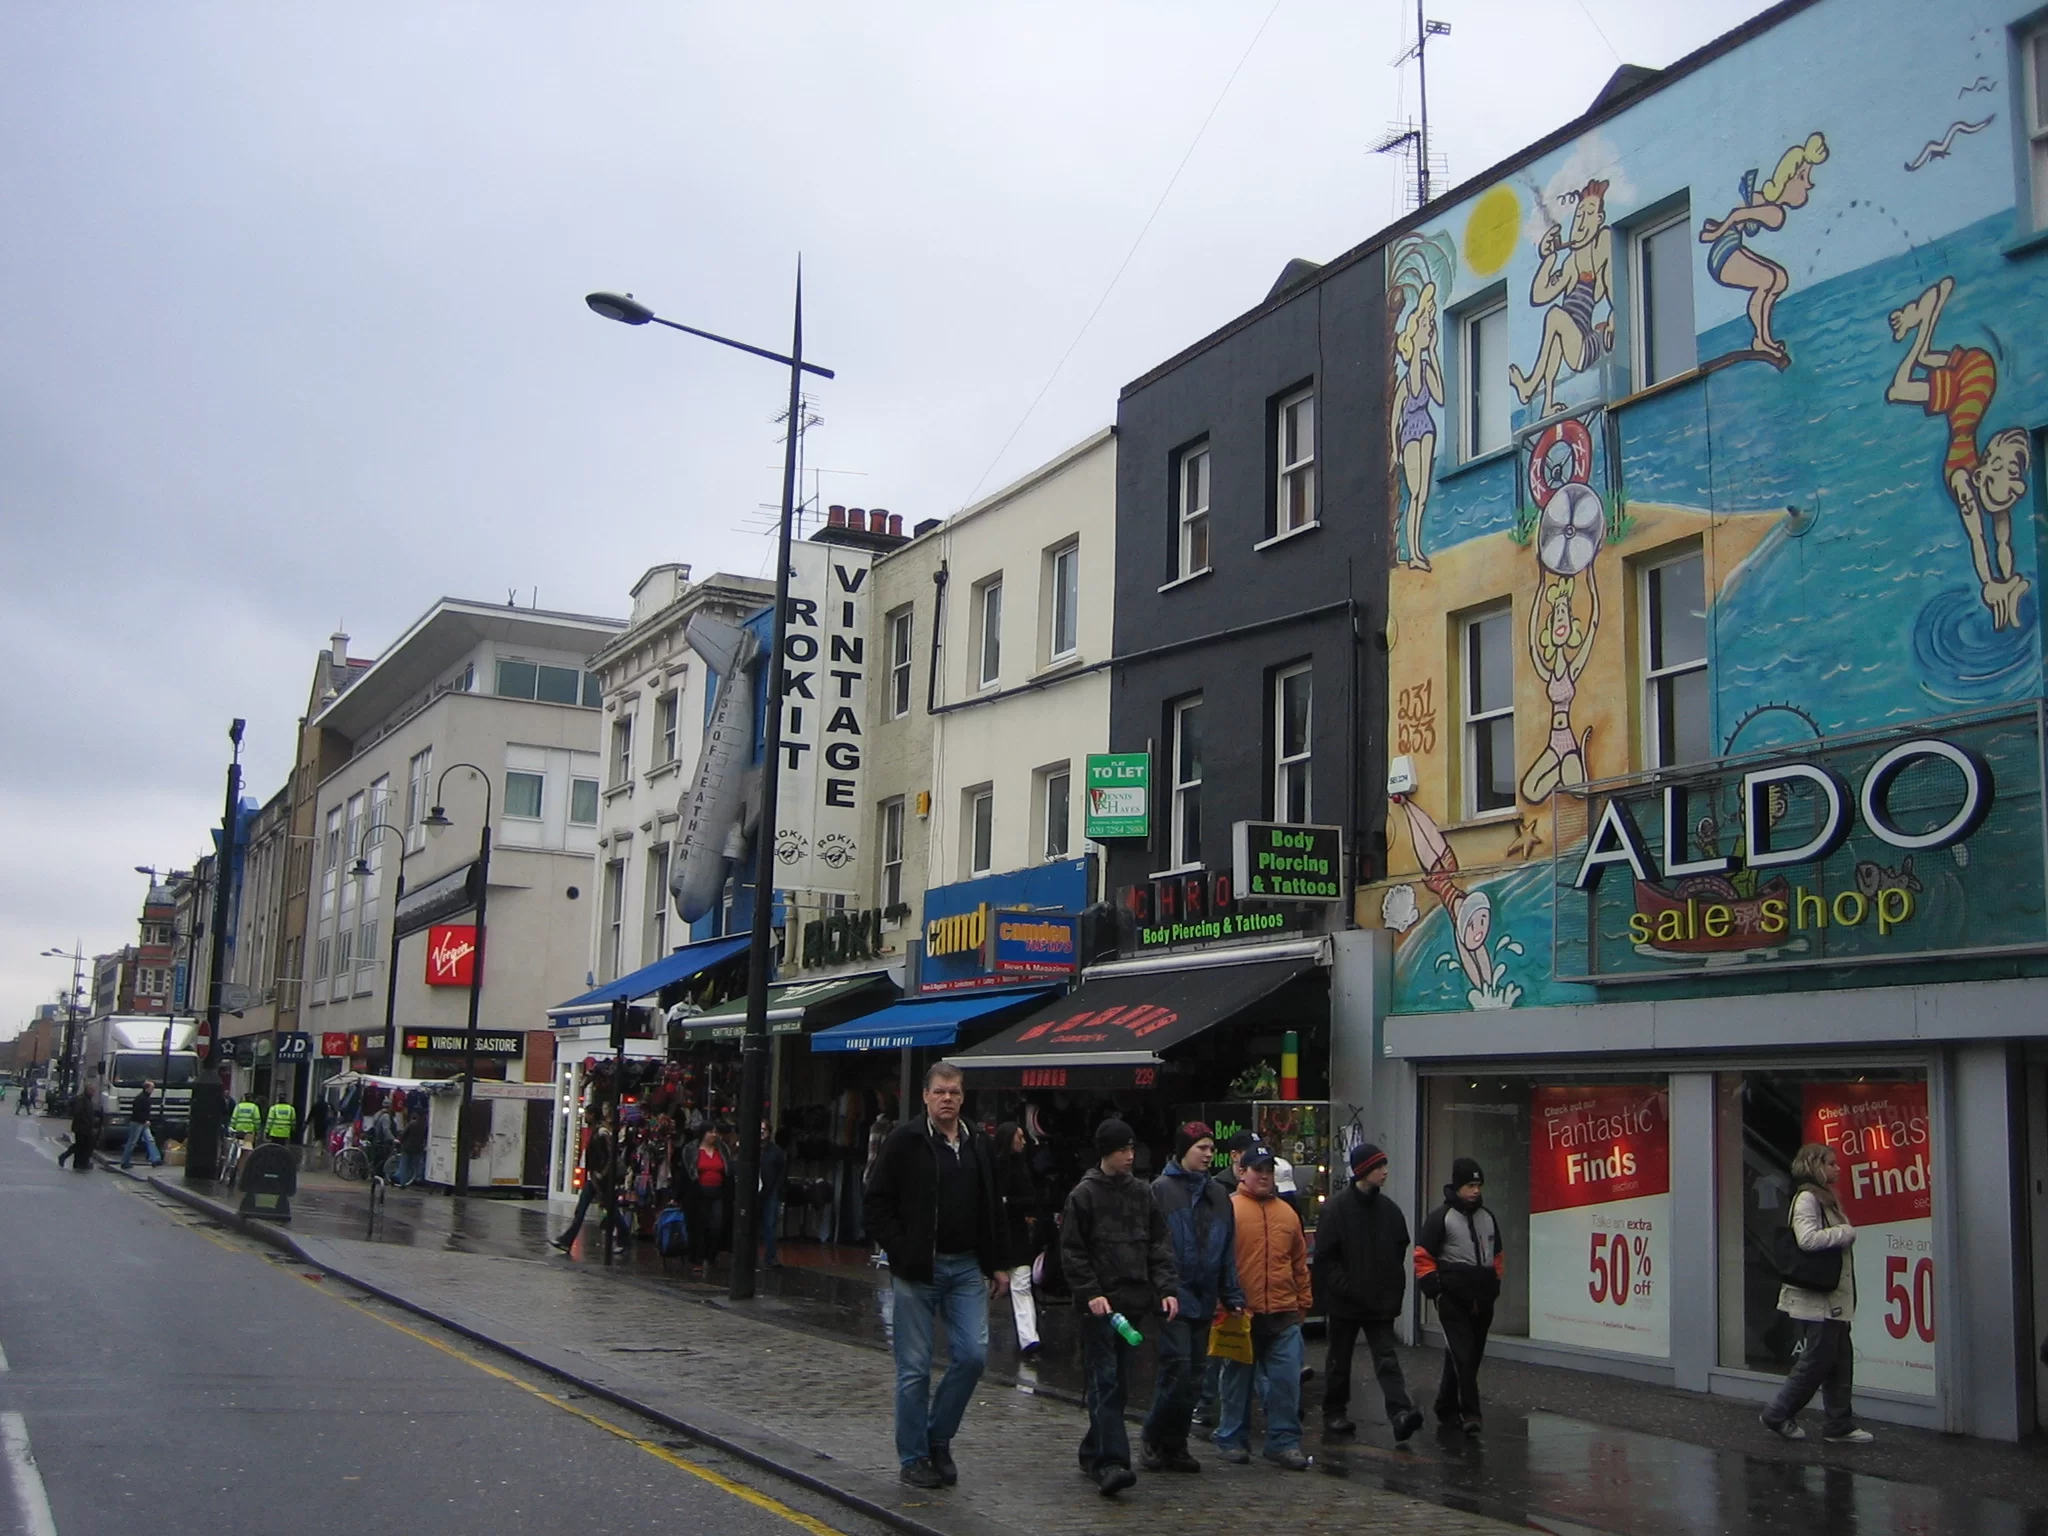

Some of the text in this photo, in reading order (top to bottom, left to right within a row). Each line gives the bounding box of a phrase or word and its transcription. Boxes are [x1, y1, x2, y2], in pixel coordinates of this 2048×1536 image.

[779, 597, 819, 770] ROKIT
[825, 564, 868, 808] VINTAGE
[1398, 678, 1436, 721] 231
[708, 731, 722, 757] OF
[1093, 767, 1144, 778] TO LET
[680, 764, 710, 861] LEATHER
[1573, 738, 1994, 890] ALDO
[817, 833, 857, 848] ROKIT
[1271, 830, 1314, 852] Body
[1258, 852, 1329, 875] Piercing
[1252, 875, 1337, 896] & Tattoos
[927, 902, 992, 957] camd
[1000, 921, 1071, 942] camden
[1143, 911, 1284, 945] Body Piercing & Tattoos
[1629, 886, 1916, 944] sale shop
[432, 931, 475, 977] Virgin
[431, 1036, 462, 1050] VIRGIN
[1547, 1104, 1653, 1150] Fantastic
[1818, 1104, 1851, 1120] Check
[1852, 1101, 1870, 1112] out
[1871, 1100, 1889, 1109] our
[1822, 1115, 1930, 1156] Fantas
[1566, 1145, 1637, 1185] Finds
[1592, 1214, 1611, 1228] Take
[1627, 1218, 1652, 1231] extra
[1886, 1235, 1914, 1250] Take
[1884, 1255, 1935, 1343] 50
